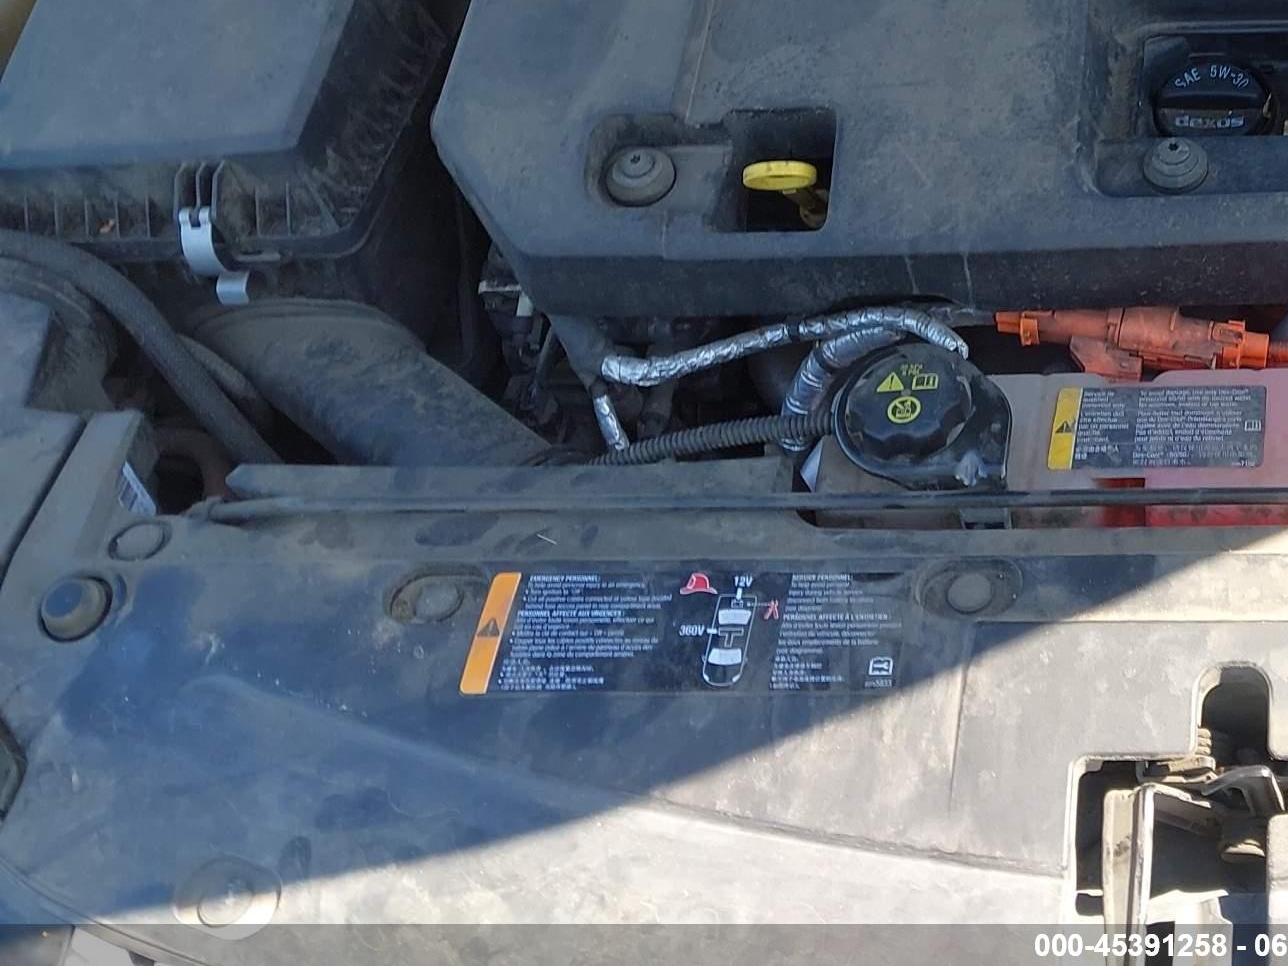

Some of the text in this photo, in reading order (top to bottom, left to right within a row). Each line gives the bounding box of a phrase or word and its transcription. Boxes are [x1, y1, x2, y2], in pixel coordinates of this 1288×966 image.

[1174, 64, 1250, 89] SAE 5W-30
[734, 575, 753, 587] 12V
[679, 624, 705, 636] 360V
